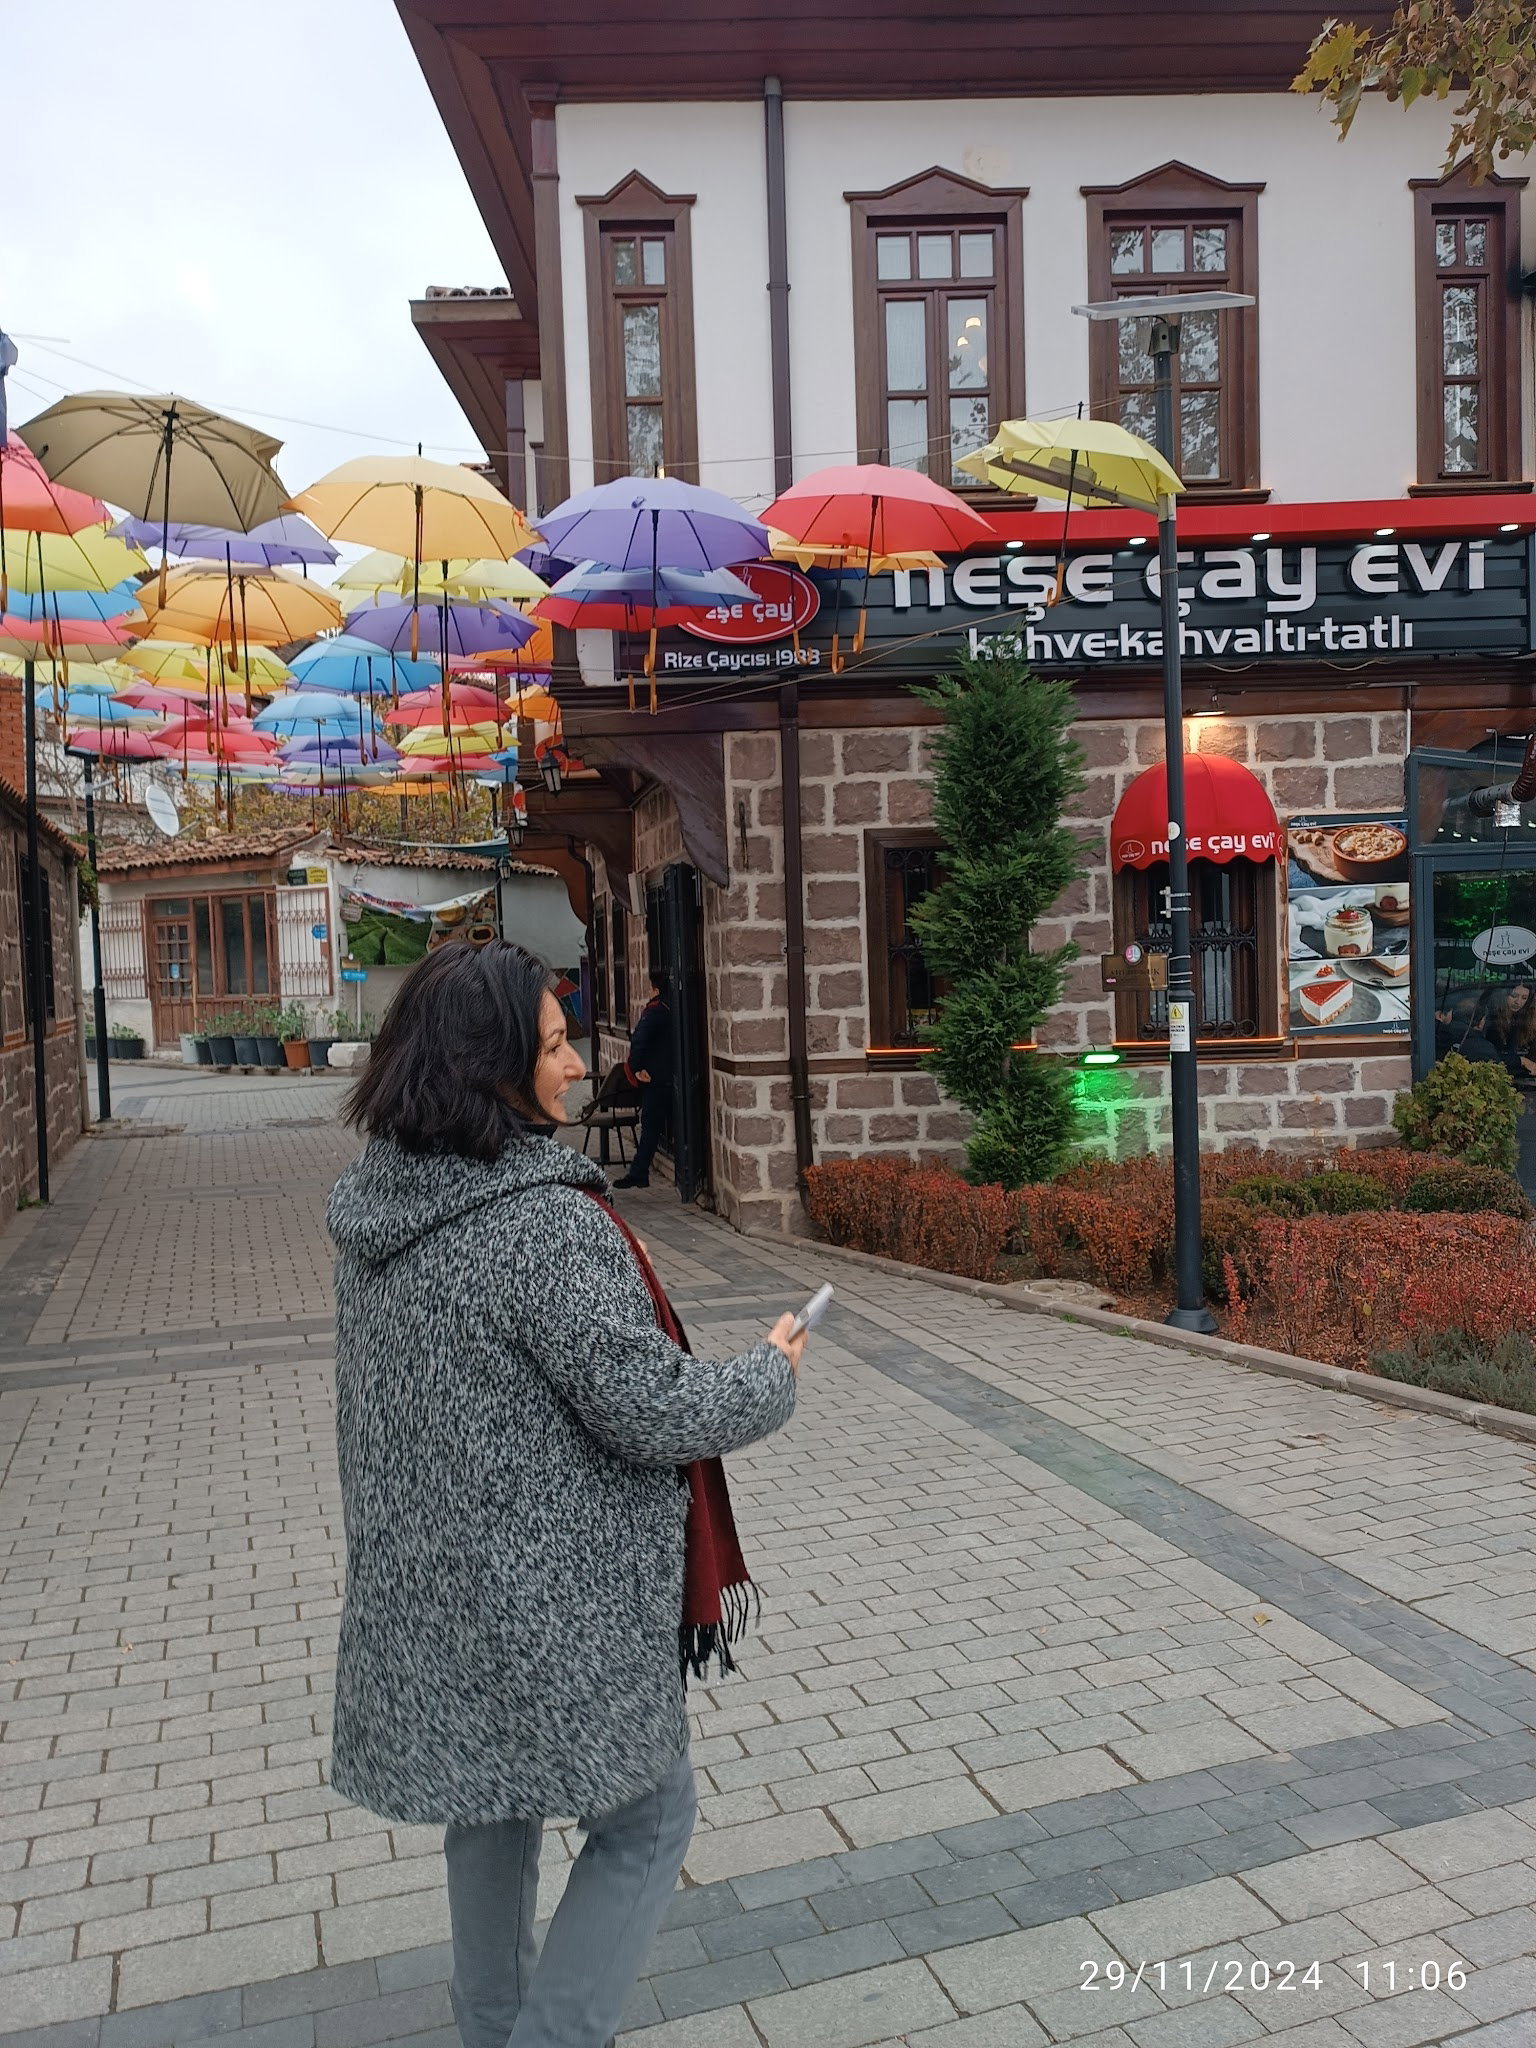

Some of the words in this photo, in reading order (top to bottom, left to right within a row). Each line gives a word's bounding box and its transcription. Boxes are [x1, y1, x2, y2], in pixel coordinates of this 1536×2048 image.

[1145, 546, 1317, 617] çay
[1349, 540, 1486, 593] evi
[752, 602, 793, 623] çay
[664, 651, 703, 668] Rize
[707, 650, 771, 671] Çaycısı
[1207, 835, 1246, 854] çay
